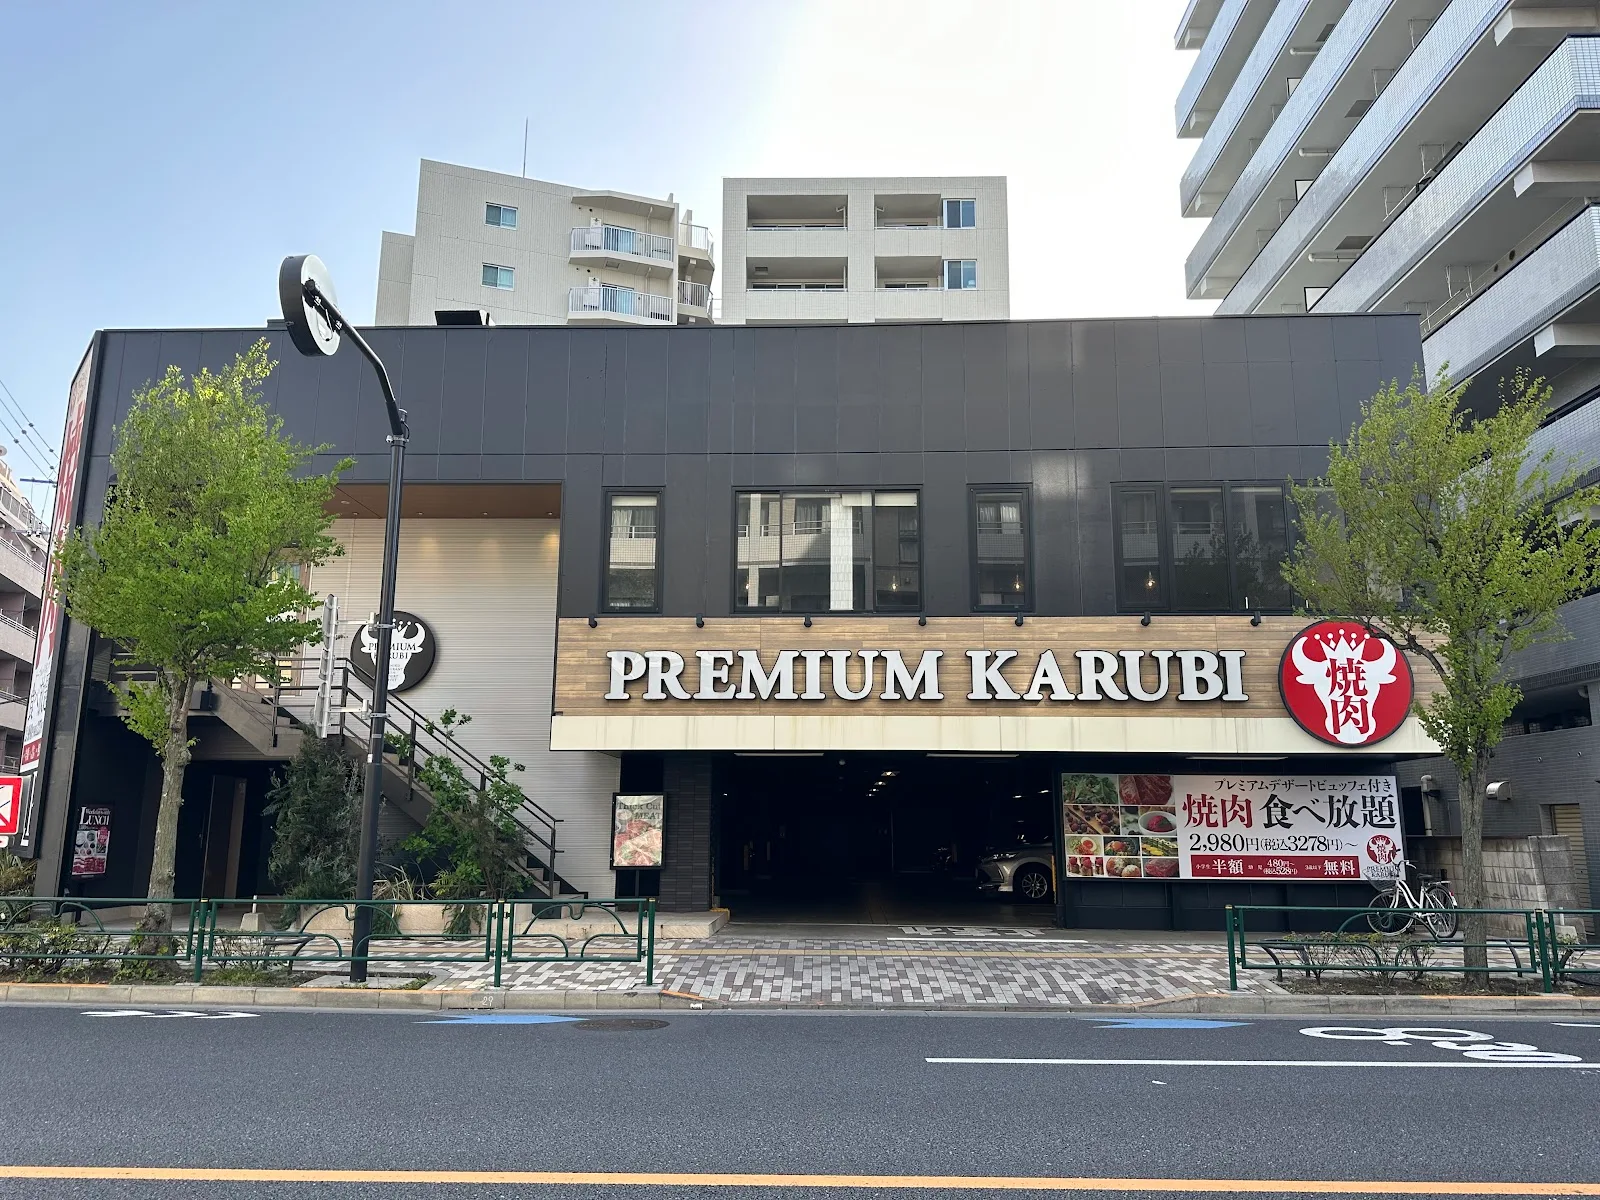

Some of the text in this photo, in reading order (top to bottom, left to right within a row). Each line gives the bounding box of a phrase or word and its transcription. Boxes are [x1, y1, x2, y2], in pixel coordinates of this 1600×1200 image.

[604, 649, 1249, 701] PREMIUM KARUBI
[1325, 657, 1369, 734] 焼肉
[1215, 778, 1391, 792] プレミアムデザートビュッフェ付き
[80, 807, 110, 825] LUNCH
[1182, 793, 1397, 829] 焼肉 食べ放題
[1212, 859, 1244, 875] 半額
[1324, 859, 1356, 876] 無料
